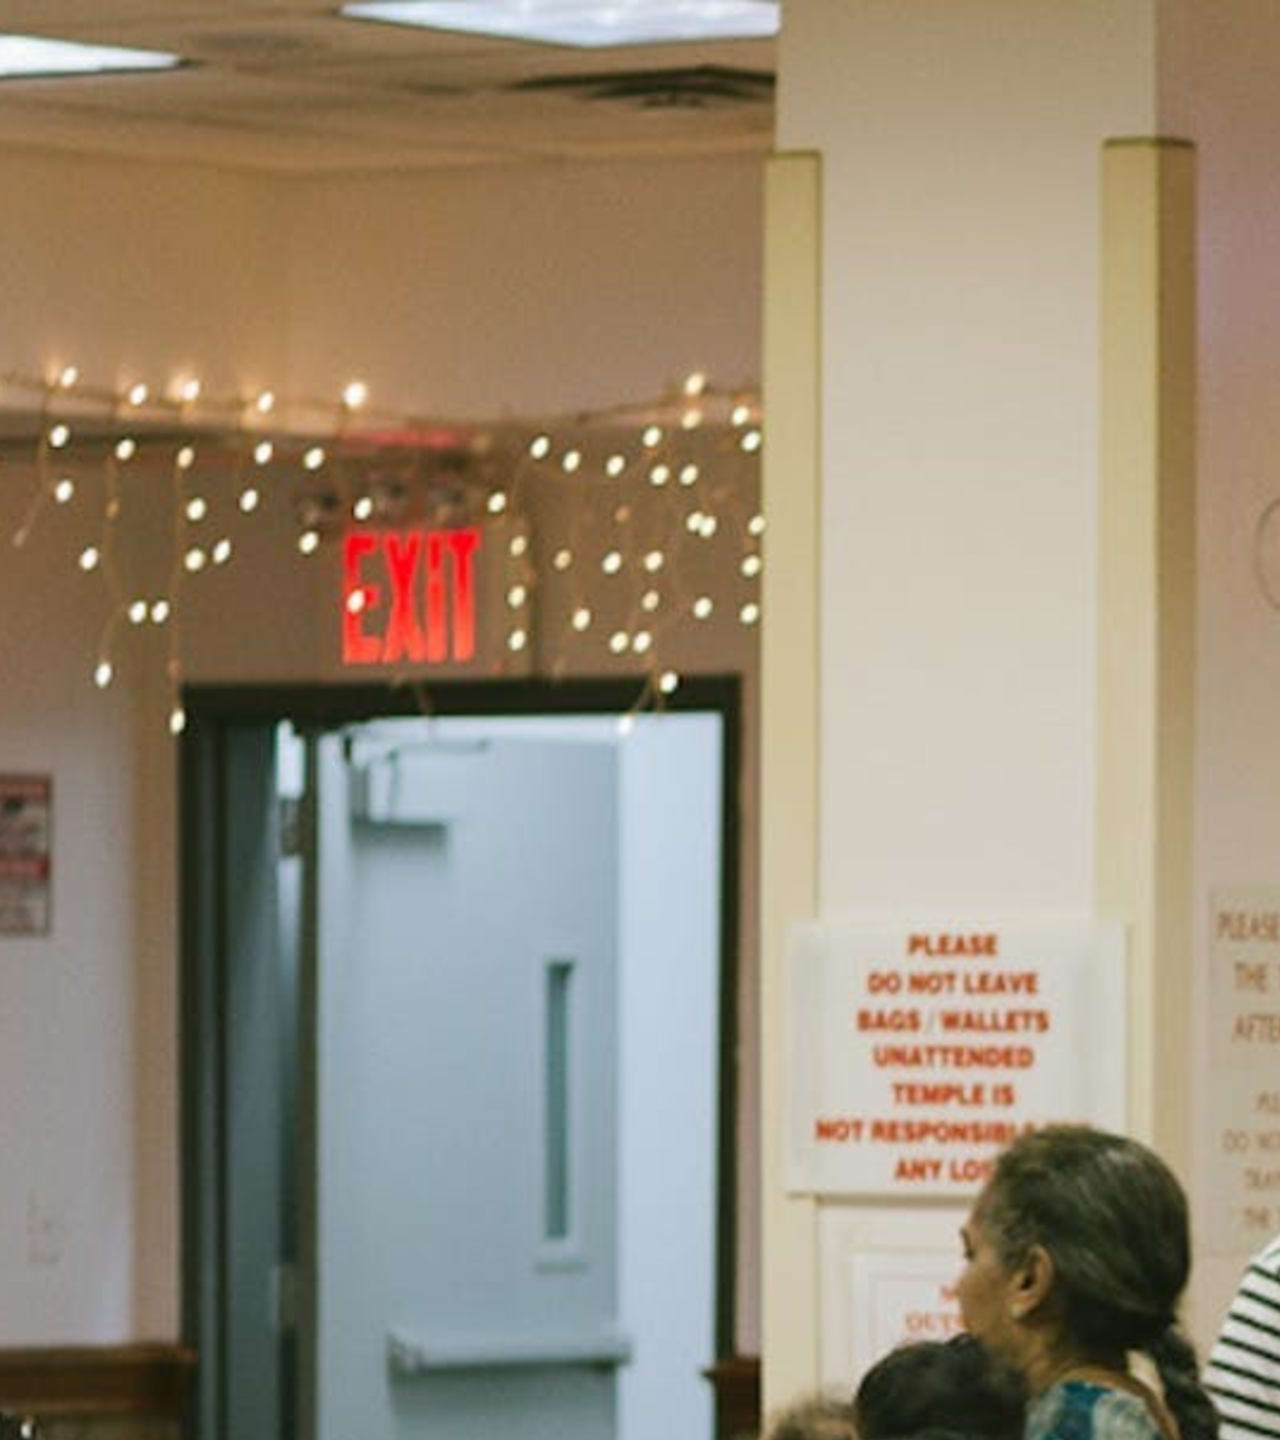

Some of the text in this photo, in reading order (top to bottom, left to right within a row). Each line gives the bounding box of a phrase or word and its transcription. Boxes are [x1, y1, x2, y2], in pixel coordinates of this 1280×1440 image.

[343, 531, 481, 664] EXIT
[1217, 912, 1279, 942] PLEASE
[907, 933, 996, 956] PLEASE
[868, 971, 1038, 994] DO NOT LEAVE
[1234, 962, 1267, 992] THE
[857, 1009, 920, 1032] BAGS
[941, 1009, 1049, 1032] WALLETS
[873, 1044, 1035, 1067] UNATTENDED
[892, 1083, 1014, 1106] TEMPLE IS
[816, 1120, 862, 1142] NOT
[894, 1158, 996, 1182] ANY LOS
